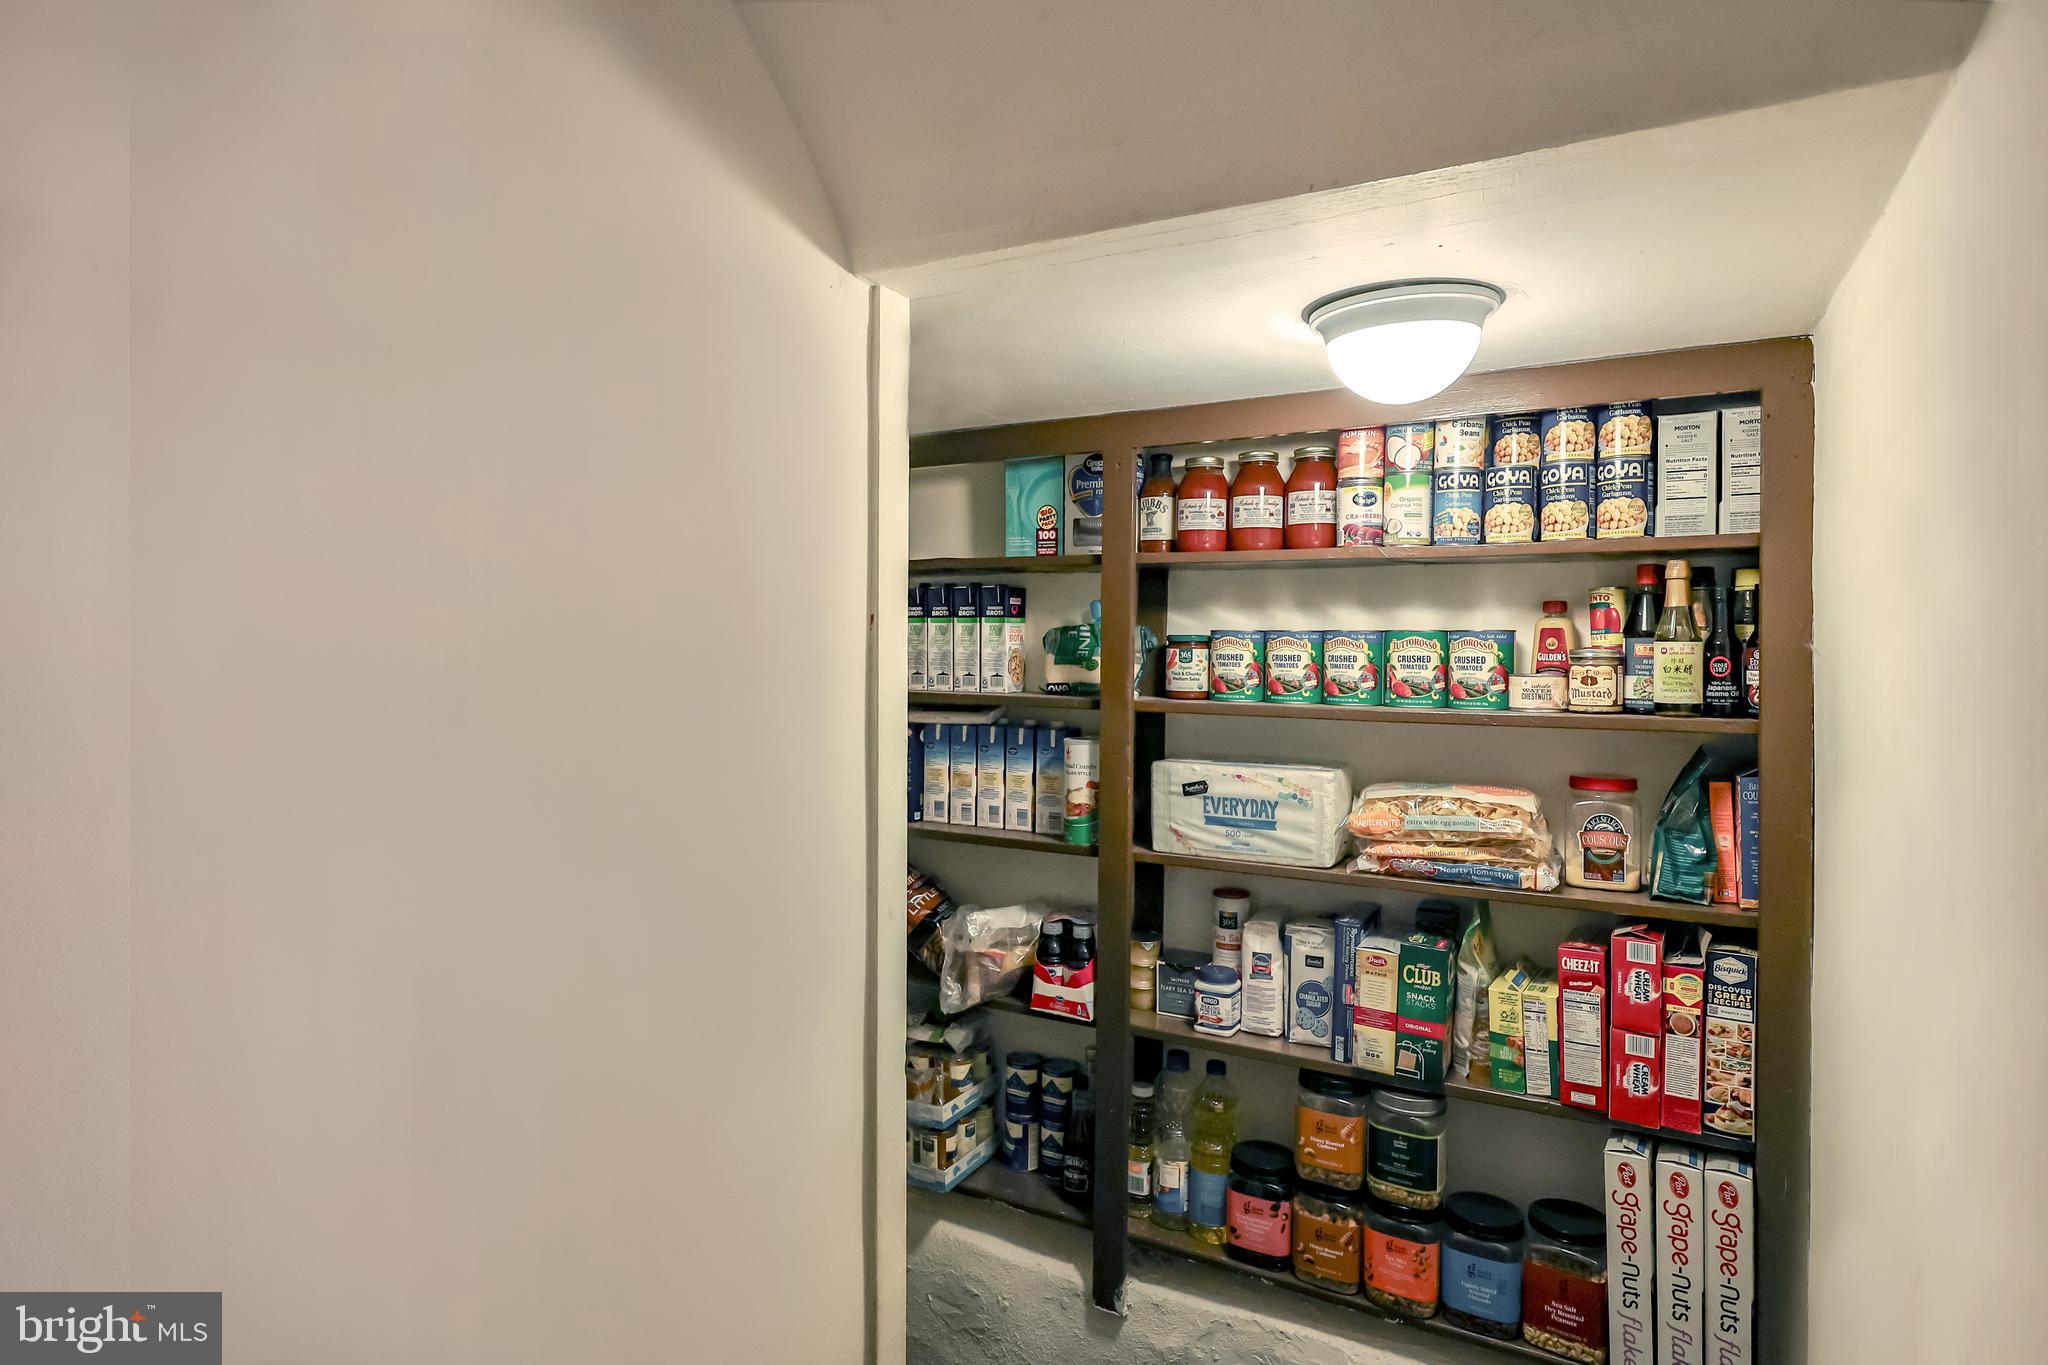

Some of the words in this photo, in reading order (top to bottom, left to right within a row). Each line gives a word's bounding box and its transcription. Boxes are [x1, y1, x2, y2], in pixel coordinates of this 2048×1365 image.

[1341, 430, 1377, 439] PUMPKIN
[1487, 467, 1531, 487] GOYA
[1541, 466, 1584, 484] GOYA
[1597, 462, 1642, 481] GOYA
[1438, 474, 1479, 489] GOYA
[1039, 506, 1054, 516] BIG
[1039, 513, 1057, 523] PARTY
[1041, 519, 1055, 529] PACK
[1038, 530, 1056, 541] 100
[1213, 637, 1251, 650] TUTTOROSSO
[1269, 637, 1308, 650] TUTTOROSSO
[1325, 638, 1364, 650] TUTTOROSSO
[1392, 637, 1437, 650] TUTTOROSSO
[1451, 638, 1494, 651] TUTTOROSSO
[1179, 651, 1192, 659] 365
[1215, 653, 1244, 661] CRUSHED
[1271, 653, 1302, 662] CRUSHED
[1328, 654, 1358, 663] CRUSHED
[1397, 654, 1432, 664] CRUSHED
[1454, 655, 1486, 665] CRUSHED
[1537, 651, 1567, 662] GULDEN'S
[1399, 663, 1429, 671] TOMATOES
[1521, 693, 1552, 701] CHESTNUTS
[1571, 687, 1612, 700] Mustard
[1203, 795, 1279, 820] EVERYDAY
[1352, 818, 1399, 828] MANISCHEWITZ
[1423, 818, 1440, 826] wide
[1440, 819, 1452, 827] egg
[1452, 818, 1476, 827] noodles
[1586, 815, 1622, 834] RICESELECT
[1225, 829, 1242, 839] 500
[1581, 834, 1628, 848] COUSCOUS
[1440, 866, 1468, 876] Hearty
[1469, 867, 1514, 880] Homestyle
[908, 887, 940, 916] LITTLE
[1221, 918, 1236, 928] 365
[1403, 964, 1441, 987] CLUB
[1715, 963, 1747, 976] Bisquick
[1176, 985, 1187, 993] SEA
[1634, 971, 1643, 1002] WHEAT
[1642, 971, 1650, 1002] CREAM
[1708, 983, 1752, 996] DISCOVER
[1299, 993, 1329, 1003] GRANULATED
[1305, 999, 1322, 1008] SUGAR
[1406, 991, 1435, 1003] SNACK
[1713, 997, 1751, 1009] RECIPES
[1714, 991, 1752, 1003] GREAT
[1405, 998, 1436, 1010] STACKS
[1405, 1023, 1432, 1033] ORIGINAL
[1632, 1064, 1641, 1095] WHEAT
[1641, 1064, 1649, 1095] CREAM
[1620, 1164, 1634, 1186] Post
[1672, 1174, 1687, 1196] Post
[1721, 1183, 1734, 1206] Post
[1611, 1189, 1642, 1311] grape-nuts
[1663, 1199, 1694, 1323] grape-nuts
[1711, 1208, 1744, 1335] grape-nuts
[1544, 1304, 1556, 1316] Dry
[1557, 1309, 1584, 1323] Roasted
[1551, 1300, 1563, 1309] Sea
[1563, 1304, 1577, 1314] Salt
[1551, 1314, 1577, 1327] Peanuts
[1616, 1310, 1645, 1365] flake
